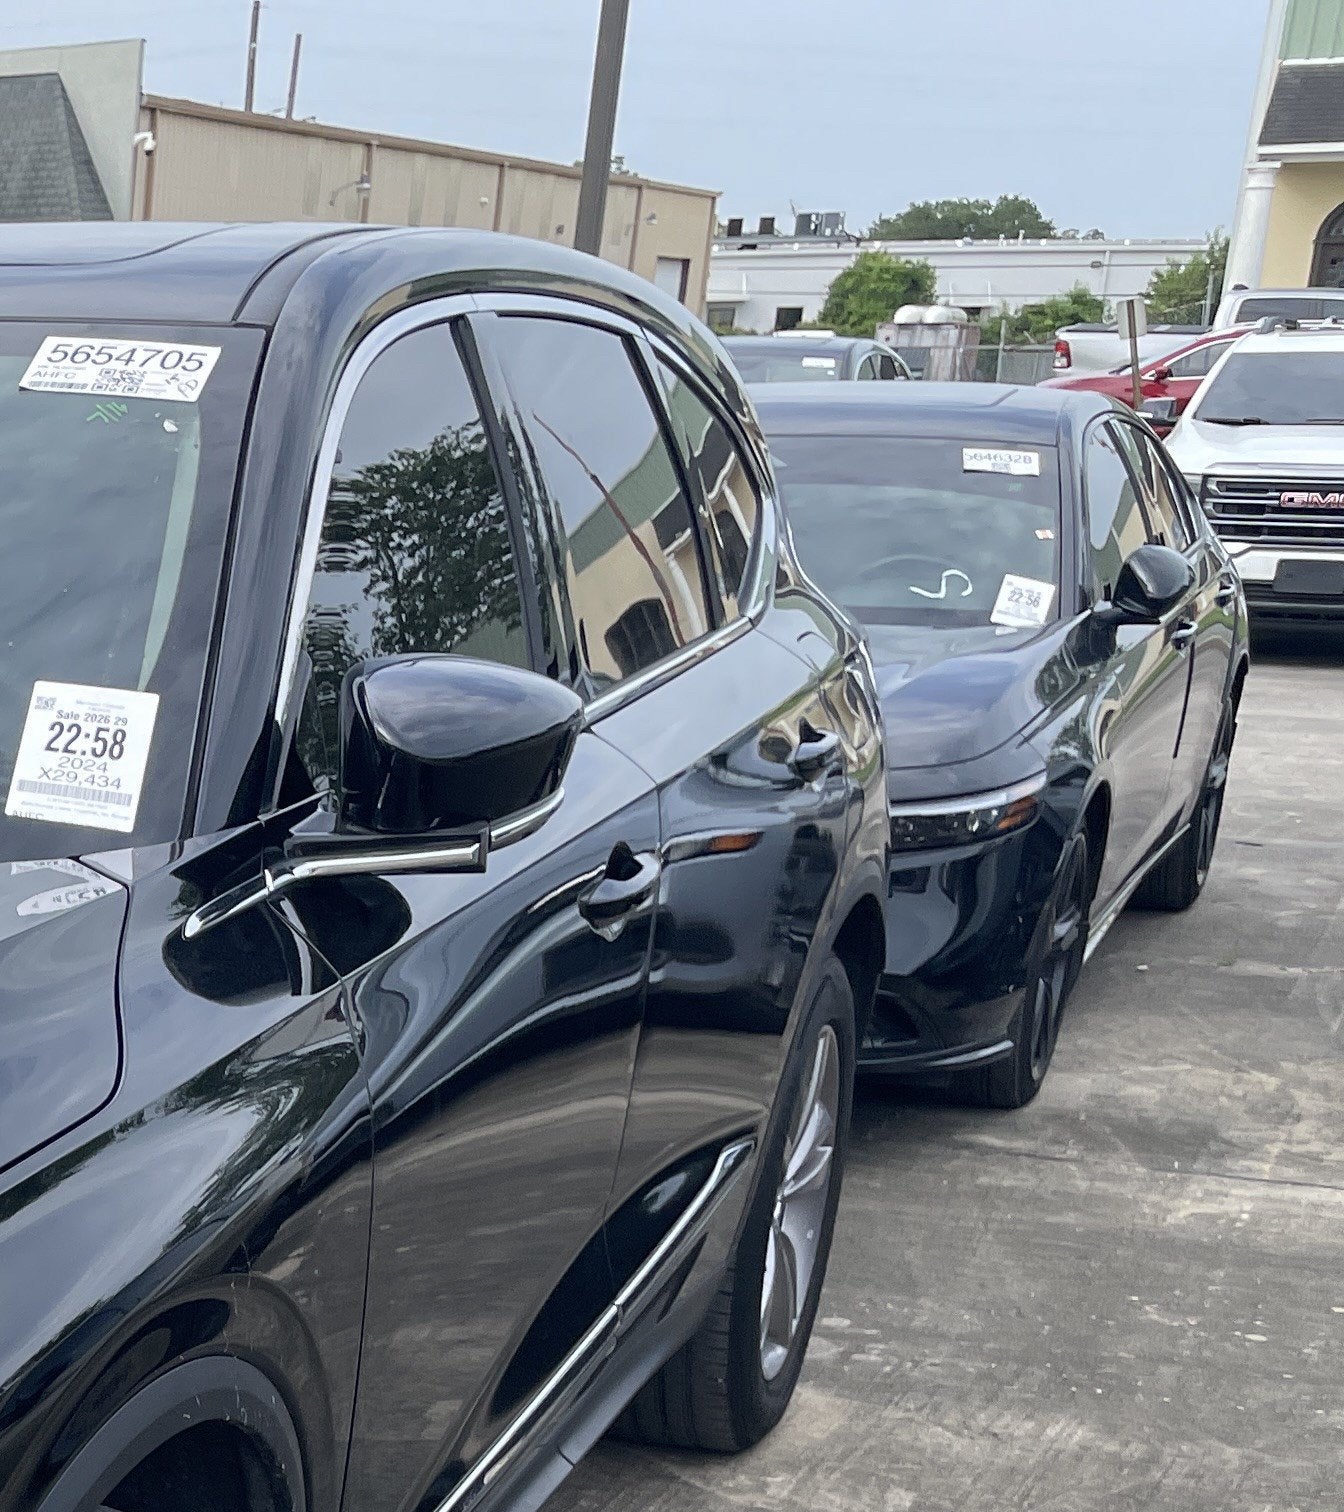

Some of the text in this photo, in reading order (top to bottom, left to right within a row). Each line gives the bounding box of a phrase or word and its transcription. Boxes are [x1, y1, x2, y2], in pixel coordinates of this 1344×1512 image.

[46, 343, 208, 373] 5654705
[1280, 492, 1344, 508] GM
[44, 721, 127, 761] 22:58
[57, 756, 109, 774] 2024
[37, 766, 122, 790] X29,434
